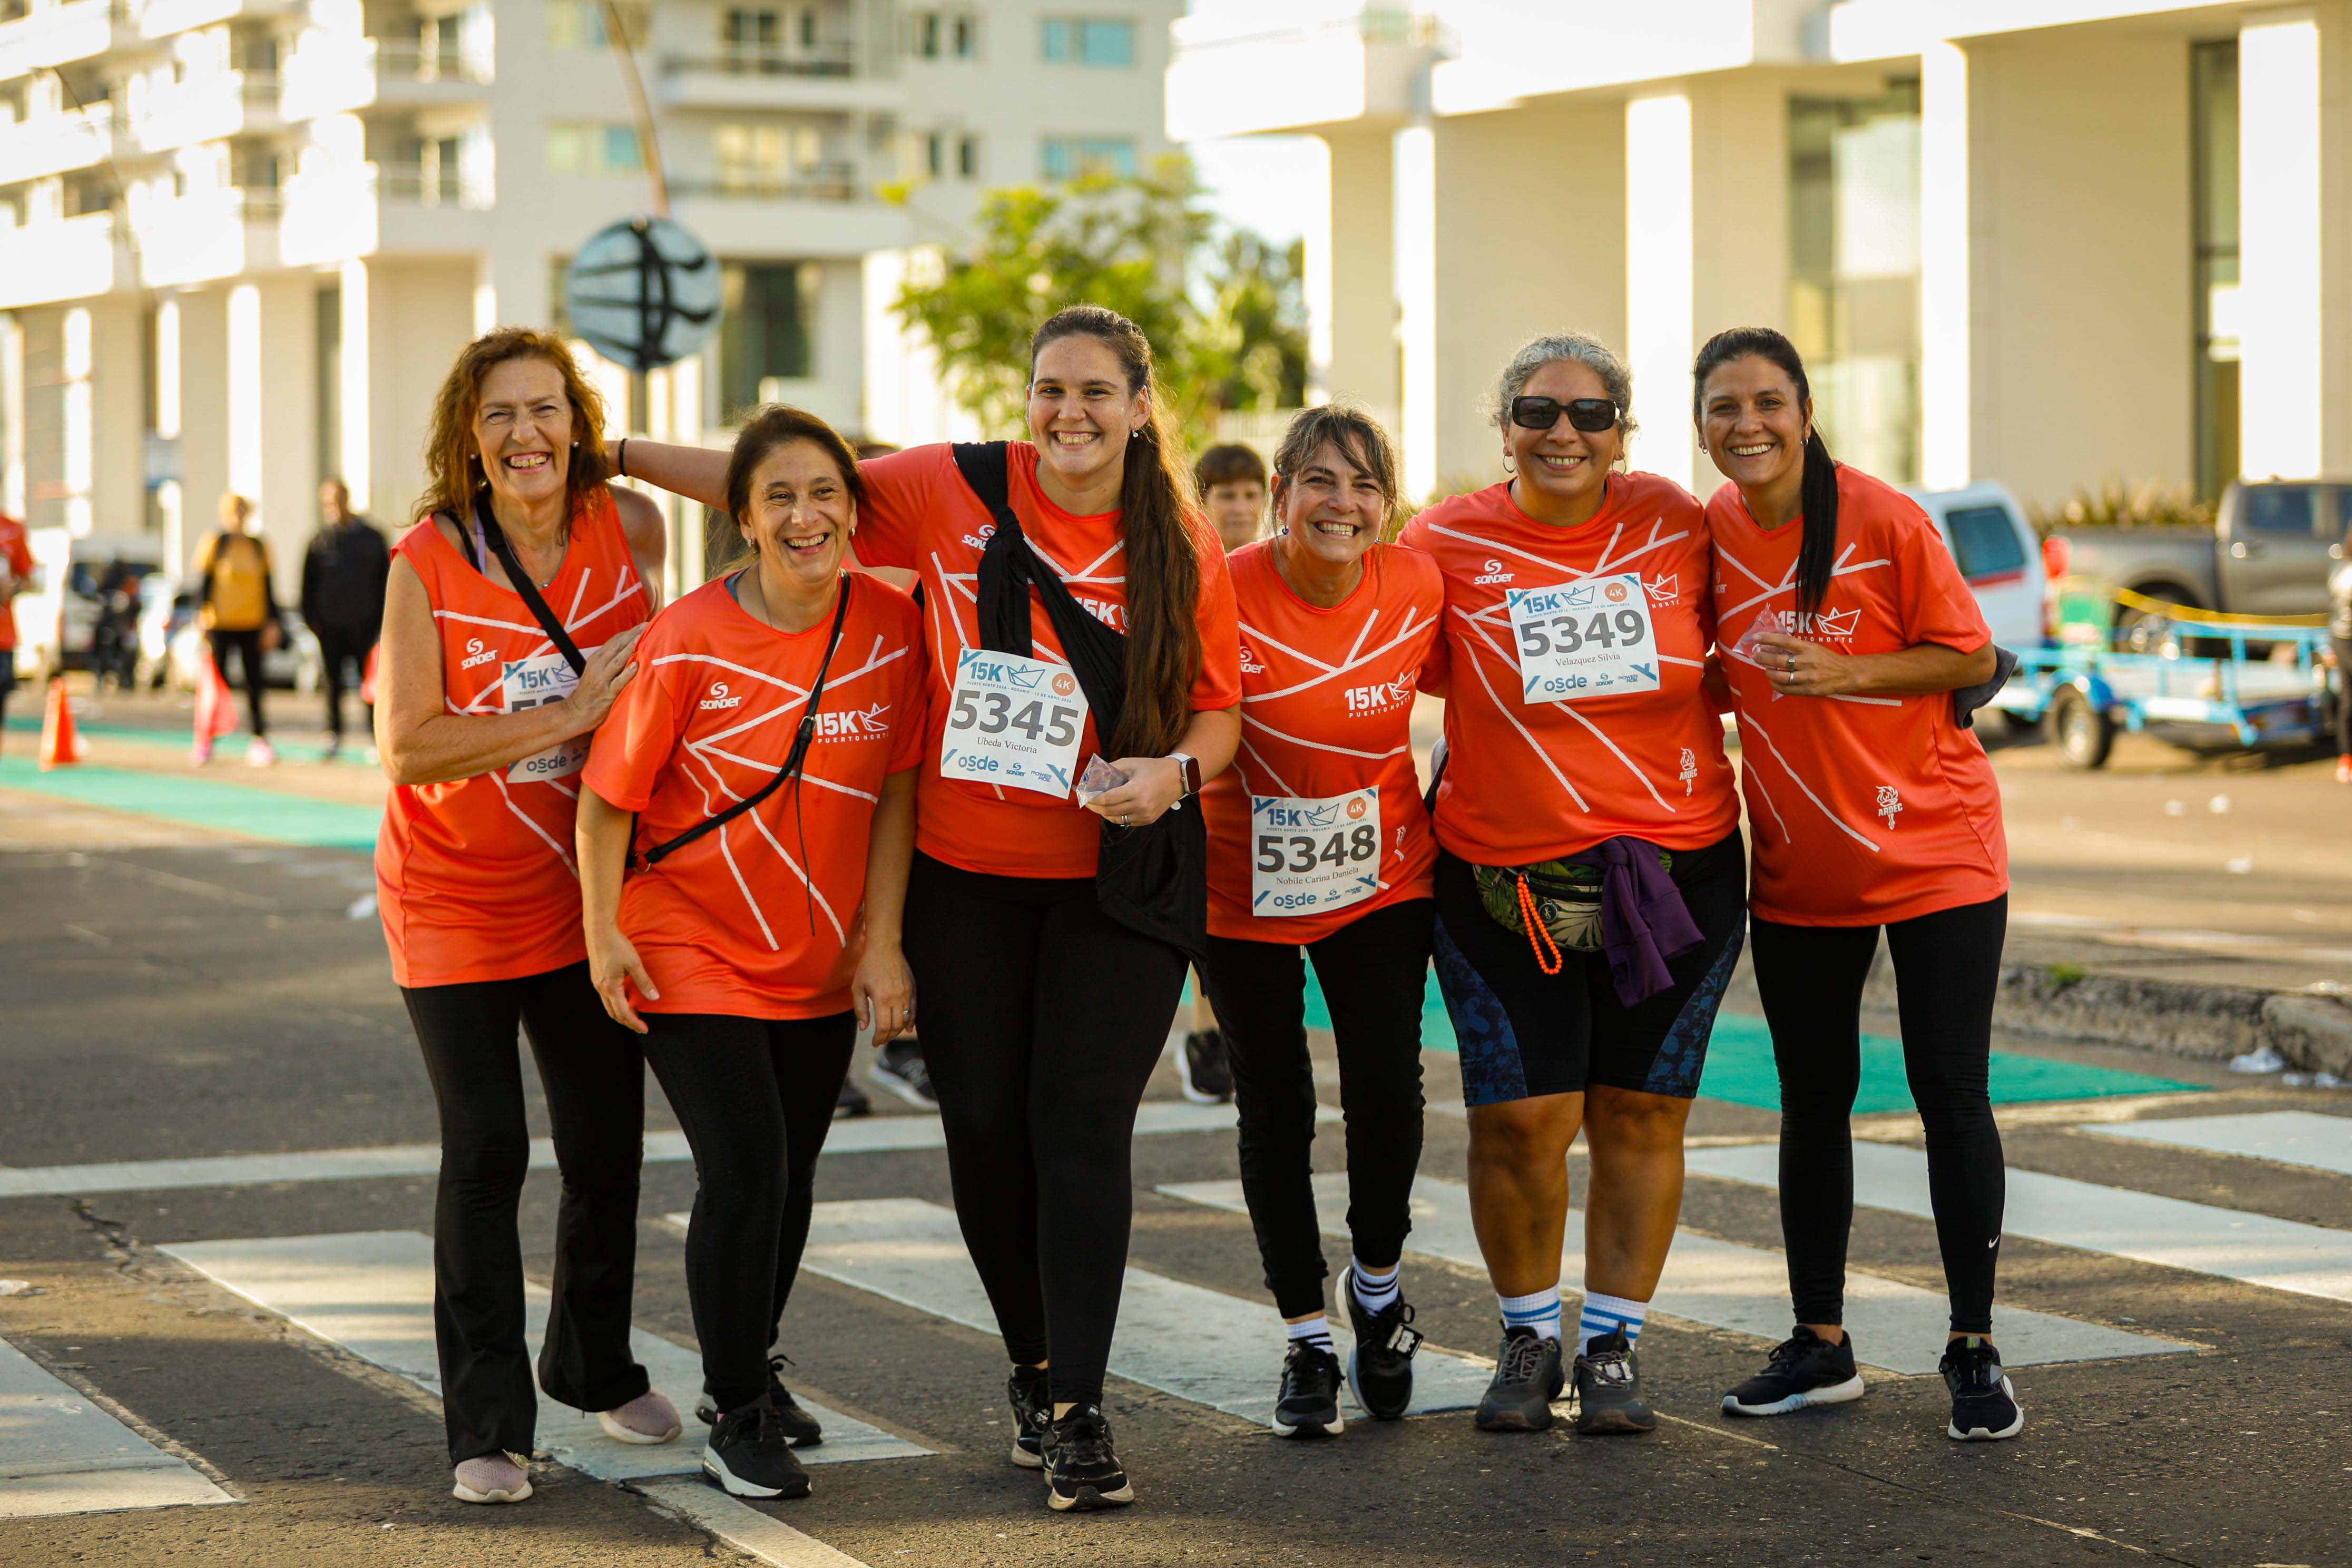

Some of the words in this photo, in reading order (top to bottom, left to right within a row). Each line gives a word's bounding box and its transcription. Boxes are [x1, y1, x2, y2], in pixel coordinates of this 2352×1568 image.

[1609, 588, 1623, 597] 4K
[1523, 594, 1561, 614] 15K
[1778, 611, 1814, 634] 15K
[1520, 609, 1645, 657] 5349
[1555, 656, 1596, 667] Velazquez
[1598, 652, 1621, 662] Silvia
[518, 668, 552, 689] 15K
[971, 661, 1004, 682] 15K
[1055, 679, 1071, 690] 4K
[1544, 674, 1587, 693] osde
[1345, 684, 1387, 710] 15K
[950, 689, 1079, 747] 5345
[1349, 707, 1387, 718] PUERTO
[815, 711, 859, 736] 15K
[818, 736, 860, 744] PUERTO
[977, 737, 1002, 748] Ubeda
[1005, 740, 1037, 753] Victoria
[527, 754, 567, 773] osde
[958, 755, 999, 772] osde
[1679, 768, 1698, 781] ARDEC
[1267, 808, 1302, 826] 15K
[1350, 804, 1364, 814] 4K
[1878, 802, 1903, 817] ARDEC
[1258, 824, 1376, 873] 5348
[1305, 875, 1330, 883] Carina
[1332, 867, 1359, 879] Daniela
[1273, 892, 1317, 909] osde
